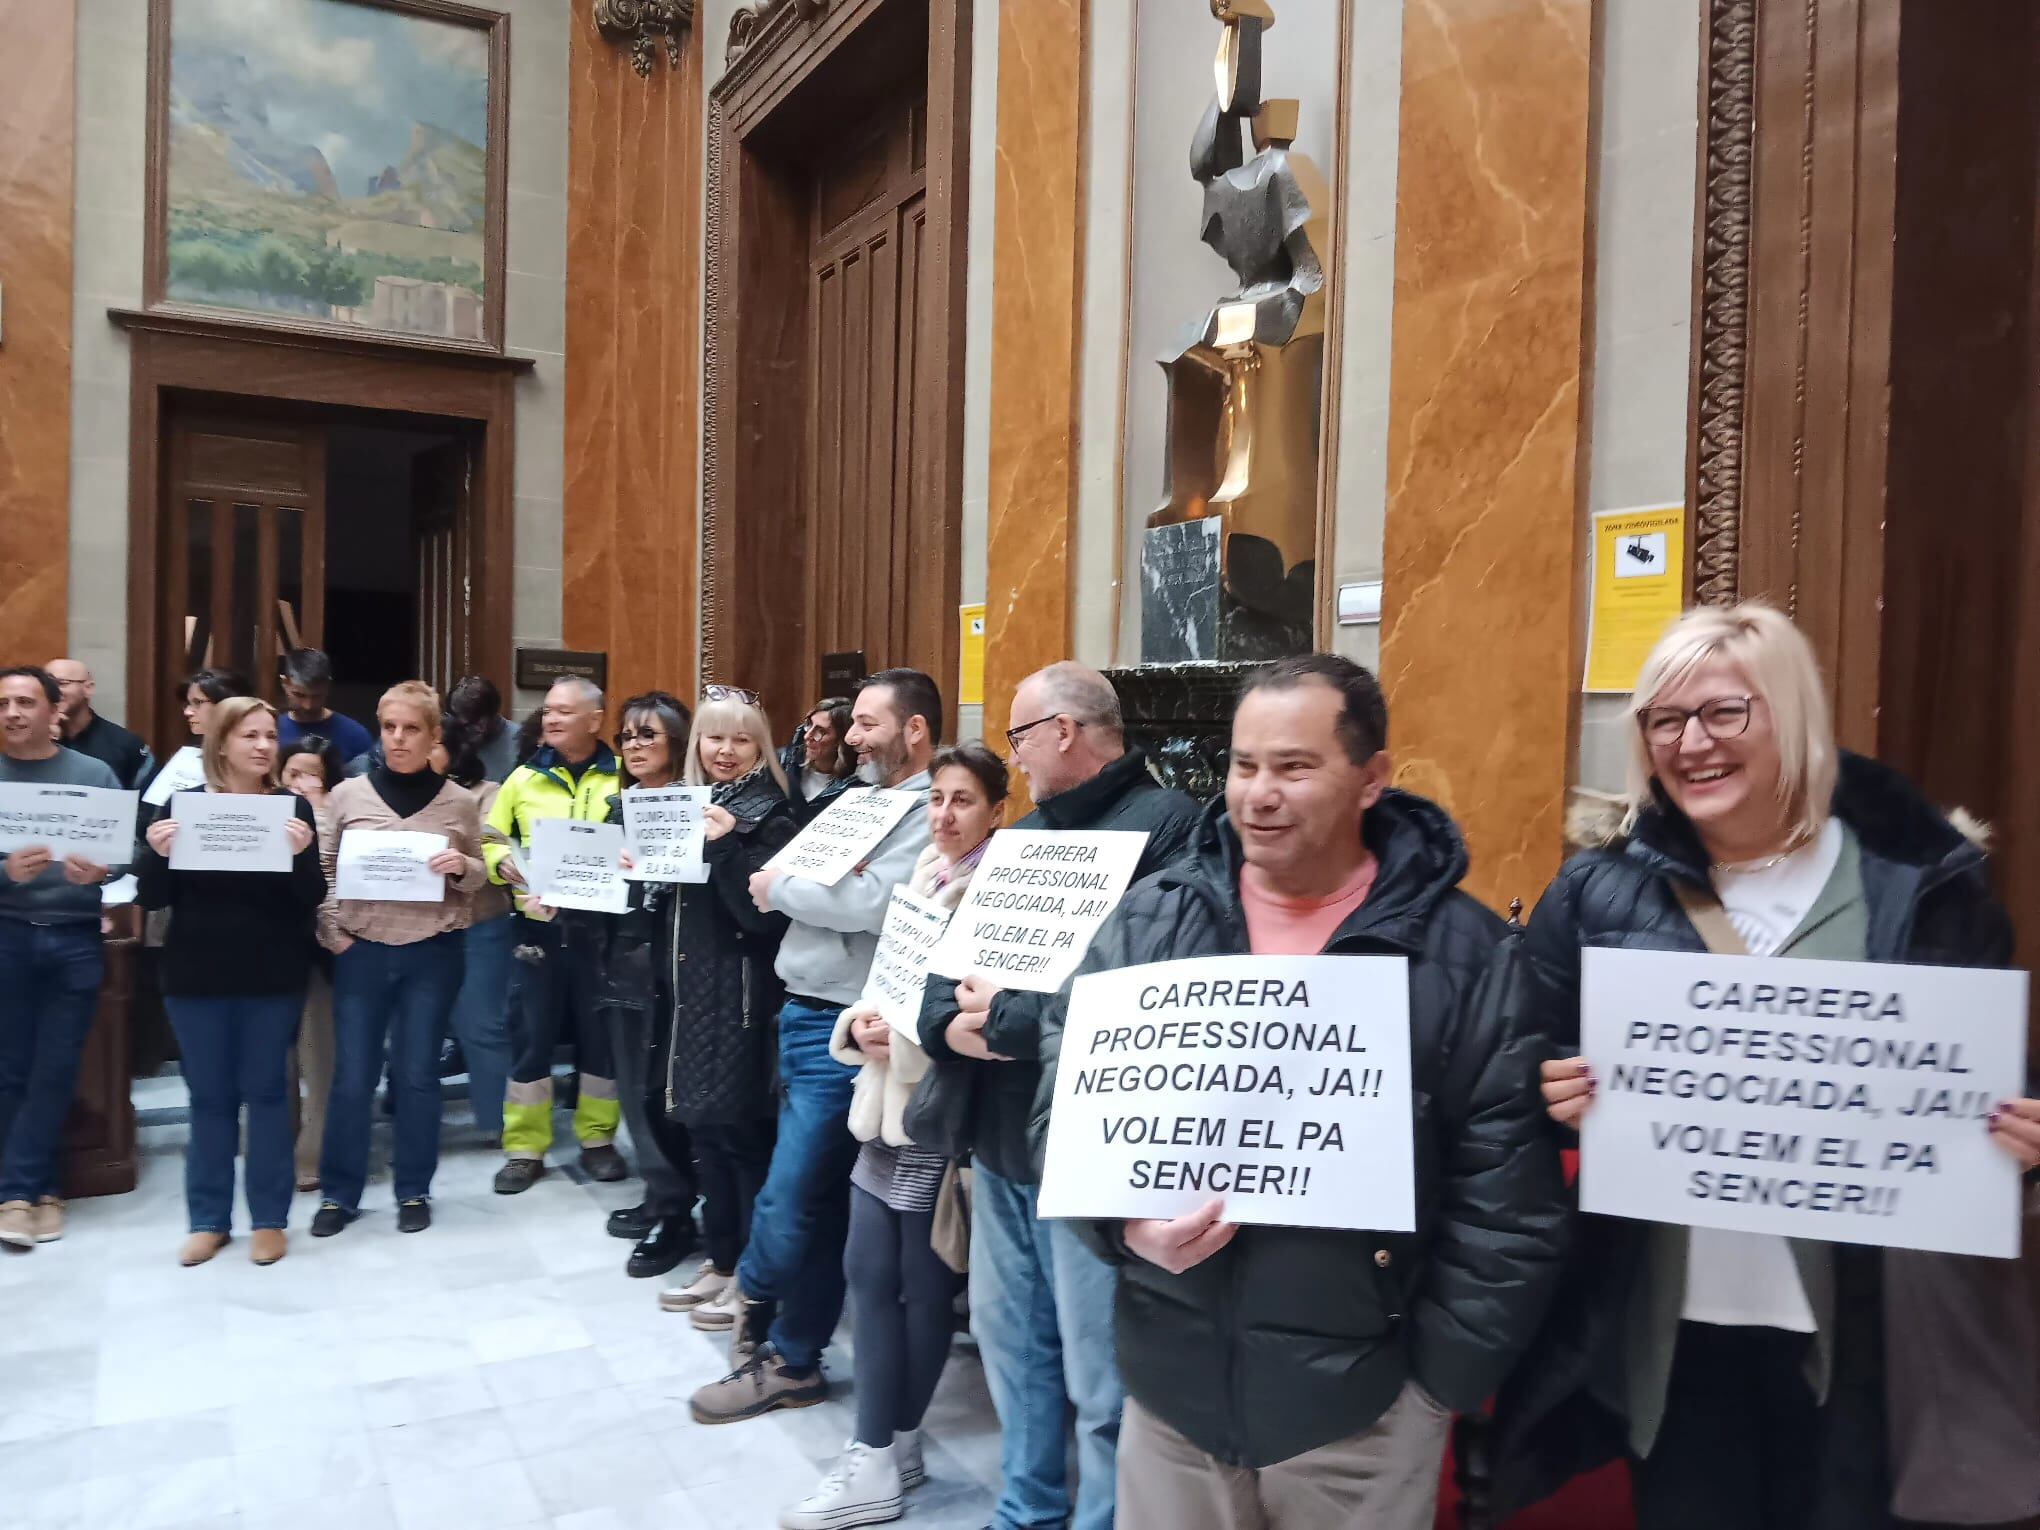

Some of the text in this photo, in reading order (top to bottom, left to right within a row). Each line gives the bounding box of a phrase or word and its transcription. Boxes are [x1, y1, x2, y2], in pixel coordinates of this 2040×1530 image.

[1020, 844, 1098, 863] CARRERA
[987, 866, 1109, 890] PROFESSIONAL
[971, 890, 1066, 918] NEGOCIADA,
[1071, 900, 1109, 917] JA!!
[973, 922, 1075, 948] VOLEM EL PA
[974, 949, 1051, 973] SENCER!!
[1138, 979, 1310, 1011] CARRERA
[1688, 980, 1906, 1023] CARRERA
[1090, 1021, 1367, 1055] PROFESSIONAL
[1624, 1020, 1973, 1074] PROFESSIONAL
[1074, 1063, 1383, 1101] NEGOCIADA, JA!!
[1609, 1064, 1995, 1121] NEGOCIADA, JA!!
[1102, 1116, 1345, 1152] VOLEM EL PA
[1650, 1121, 1940, 1175] VOLEM EL PA
[1129, 1160, 1312, 1196] SENCER!!
[1686, 1169, 1903, 1216] SENCER!!
